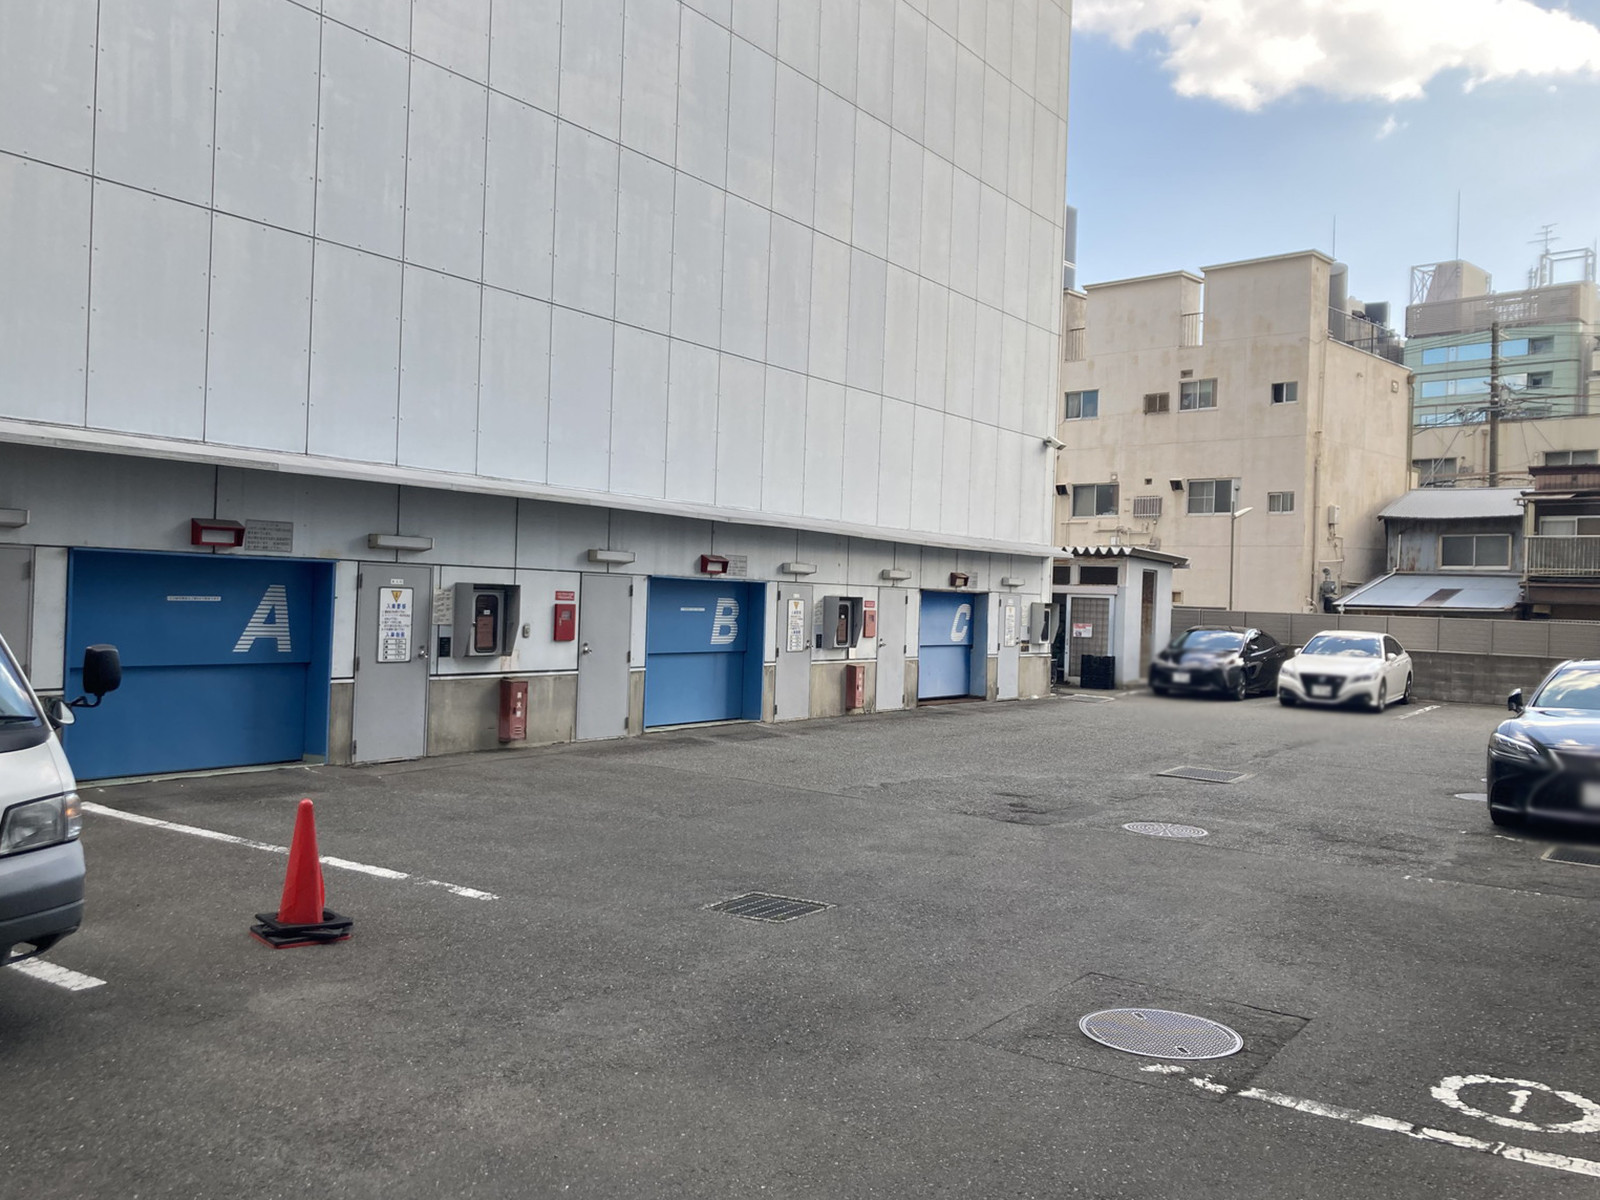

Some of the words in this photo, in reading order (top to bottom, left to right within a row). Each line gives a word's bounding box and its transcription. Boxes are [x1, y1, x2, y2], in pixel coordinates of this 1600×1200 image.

[232, 584, 292, 652] A
[710, 597, 740, 645] B
[950, 603, 971, 642] C
[1507, 1090, 1532, 1114] 1
